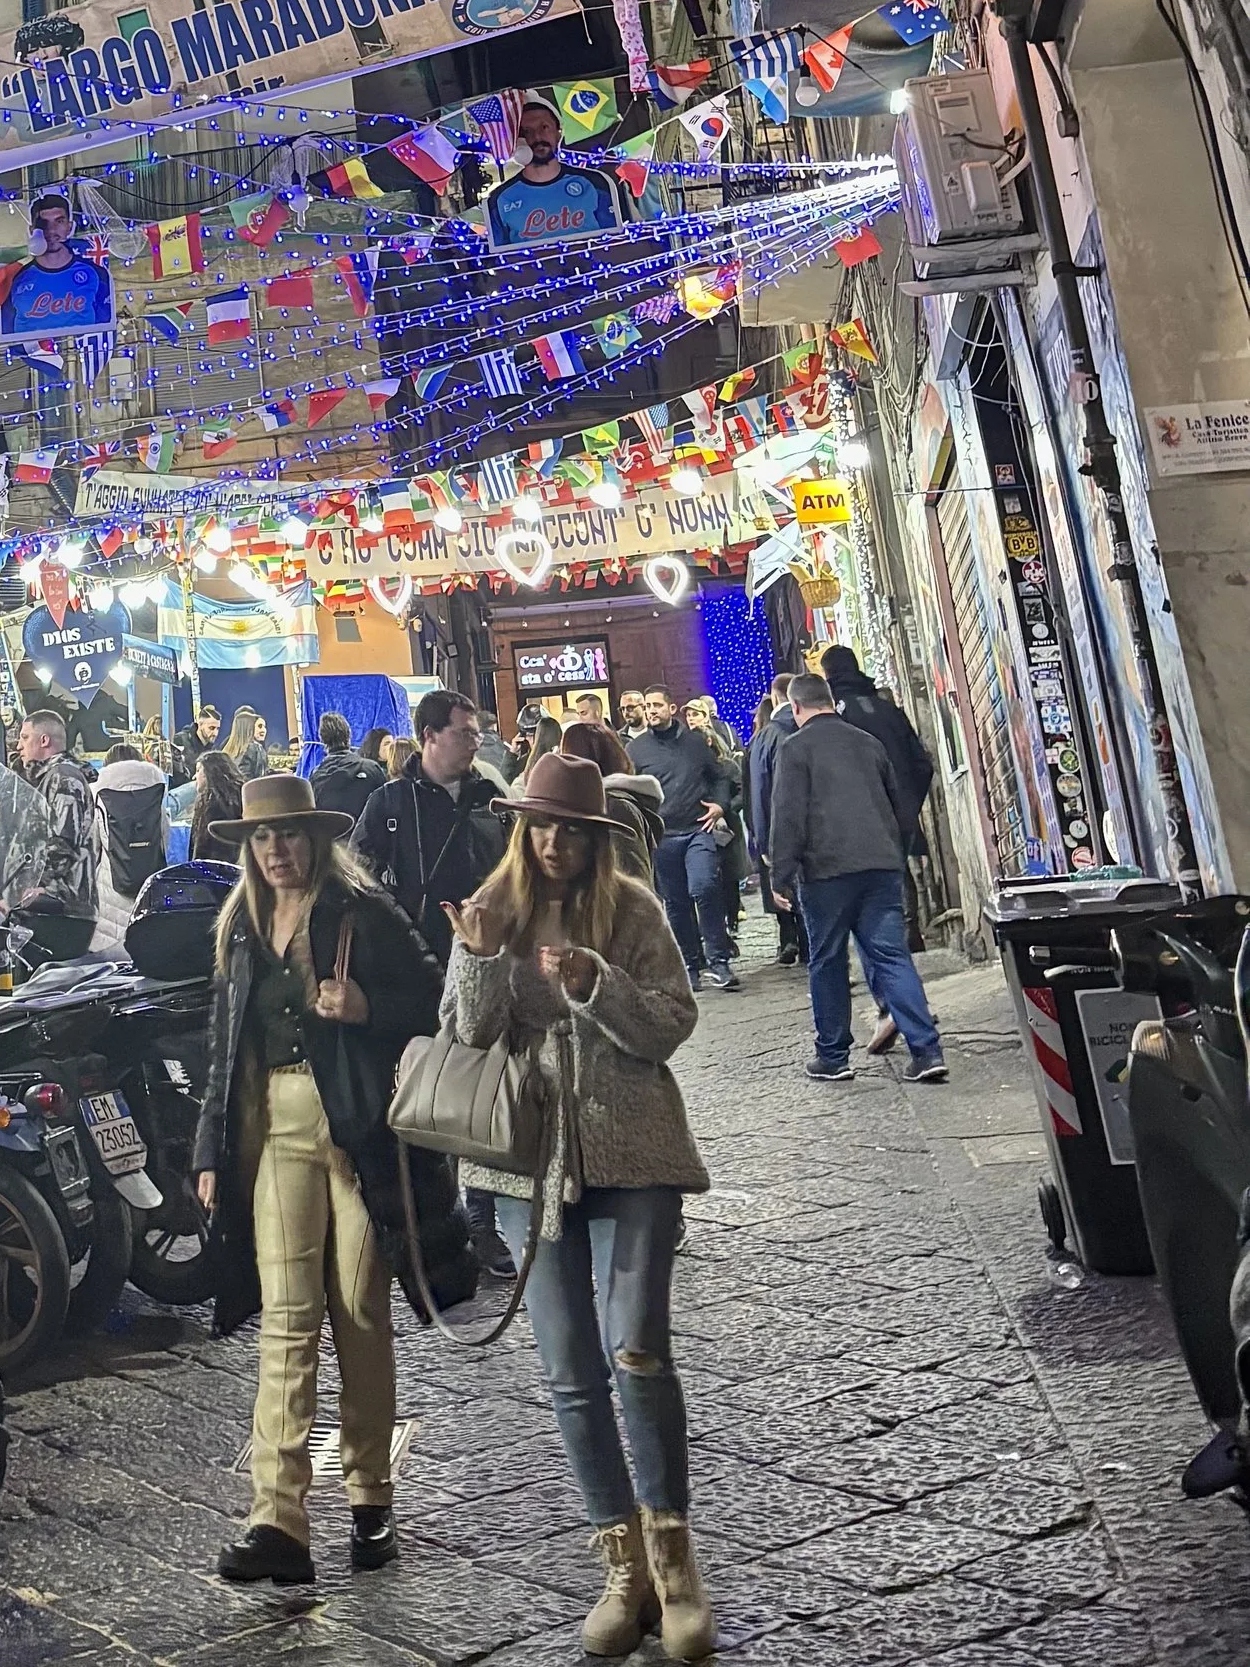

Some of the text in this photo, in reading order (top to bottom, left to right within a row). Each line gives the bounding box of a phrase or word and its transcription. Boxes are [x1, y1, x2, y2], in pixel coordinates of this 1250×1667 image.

[504, 199, 523, 212] EA7
[518, 205, 586, 238] Lete
[25, 291, 87, 318] Lete
[1185, 414, 1250, 430] La Fenice
[802, 493, 846, 510] ATM
[1012, 536, 1036, 551] BVB
[42, 627, 81, 647] DIOS
[62, 637, 116, 660] EXISTE
[91, 1097, 115, 1122] EM
[95, 1123, 141, 1153] 23052
